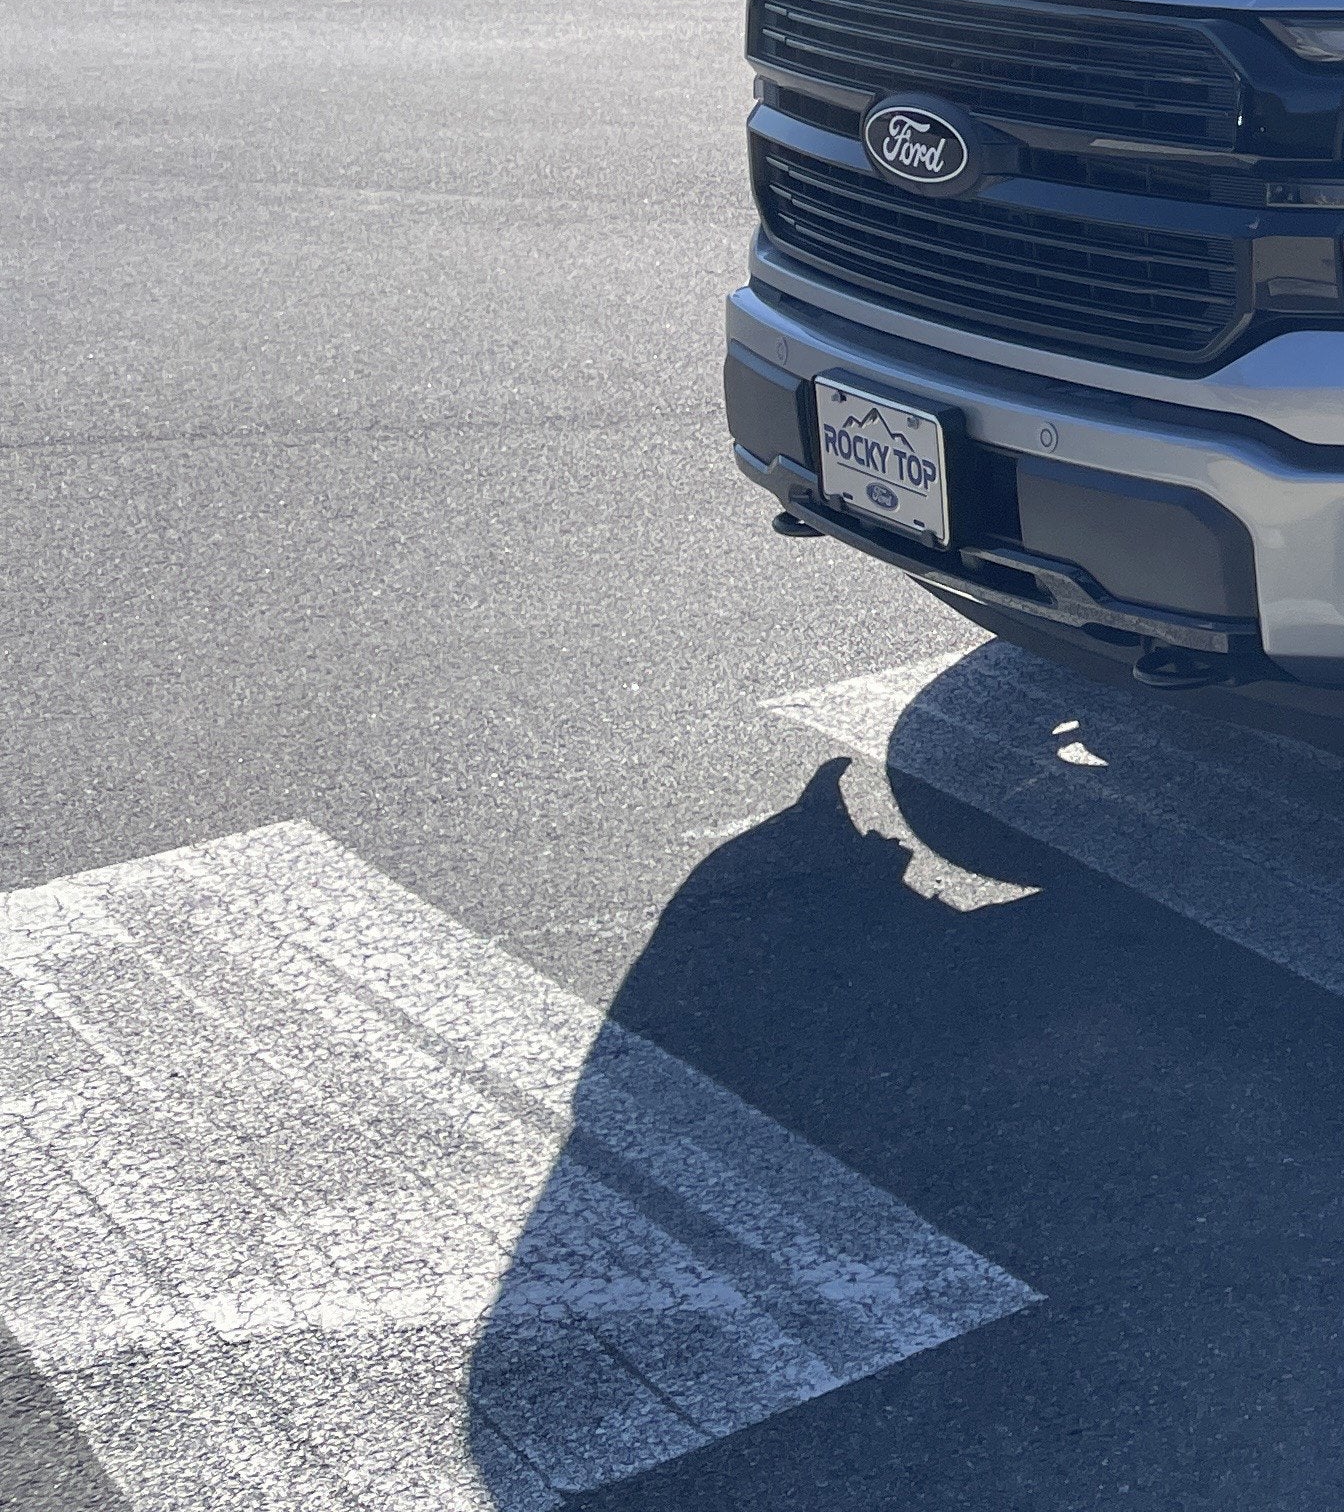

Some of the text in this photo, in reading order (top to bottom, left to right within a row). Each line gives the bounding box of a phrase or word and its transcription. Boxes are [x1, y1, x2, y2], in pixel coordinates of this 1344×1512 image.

[883, 115, 945, 173] Ford
[824, 423, 936, 490] ROCKY TOP
